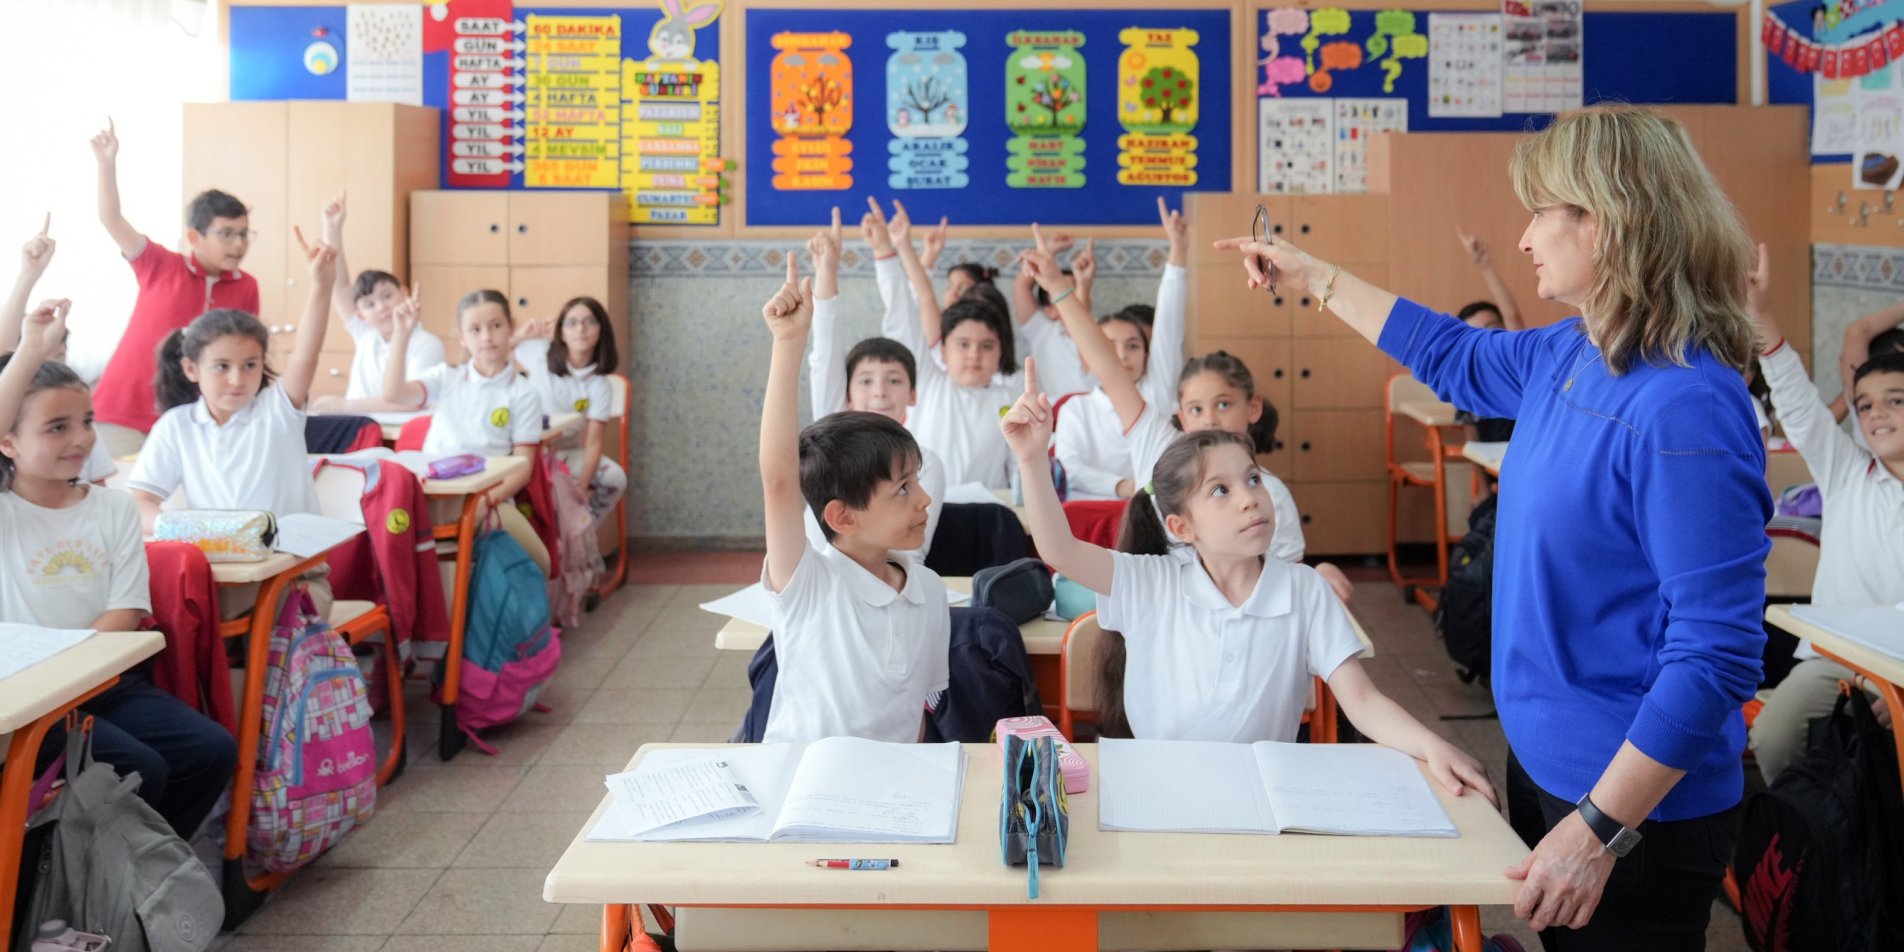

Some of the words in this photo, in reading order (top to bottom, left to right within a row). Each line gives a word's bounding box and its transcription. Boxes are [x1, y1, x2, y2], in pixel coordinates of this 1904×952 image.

[461, 22, 500, 32] SAAT
[534, 25, 551, 35] 60
[459, 58, 500, 68] HAFTA
[470, 75, 489, 86] AY
[470, 92, 489, 103] AY
[533, 93, 541, 103] 4
[547, 93, 596, 103] HAFTA
[468, 110, 491, 121] YIL
[556, 109, 605, 121] HAFTA
[467, 127, 491, 138] YIL
[533, 127, 549, 138] 12
[555, 127, 574, 138] AY
[467, 144, 491, 155] YIL
[467, 161, 491, 173] YIL
